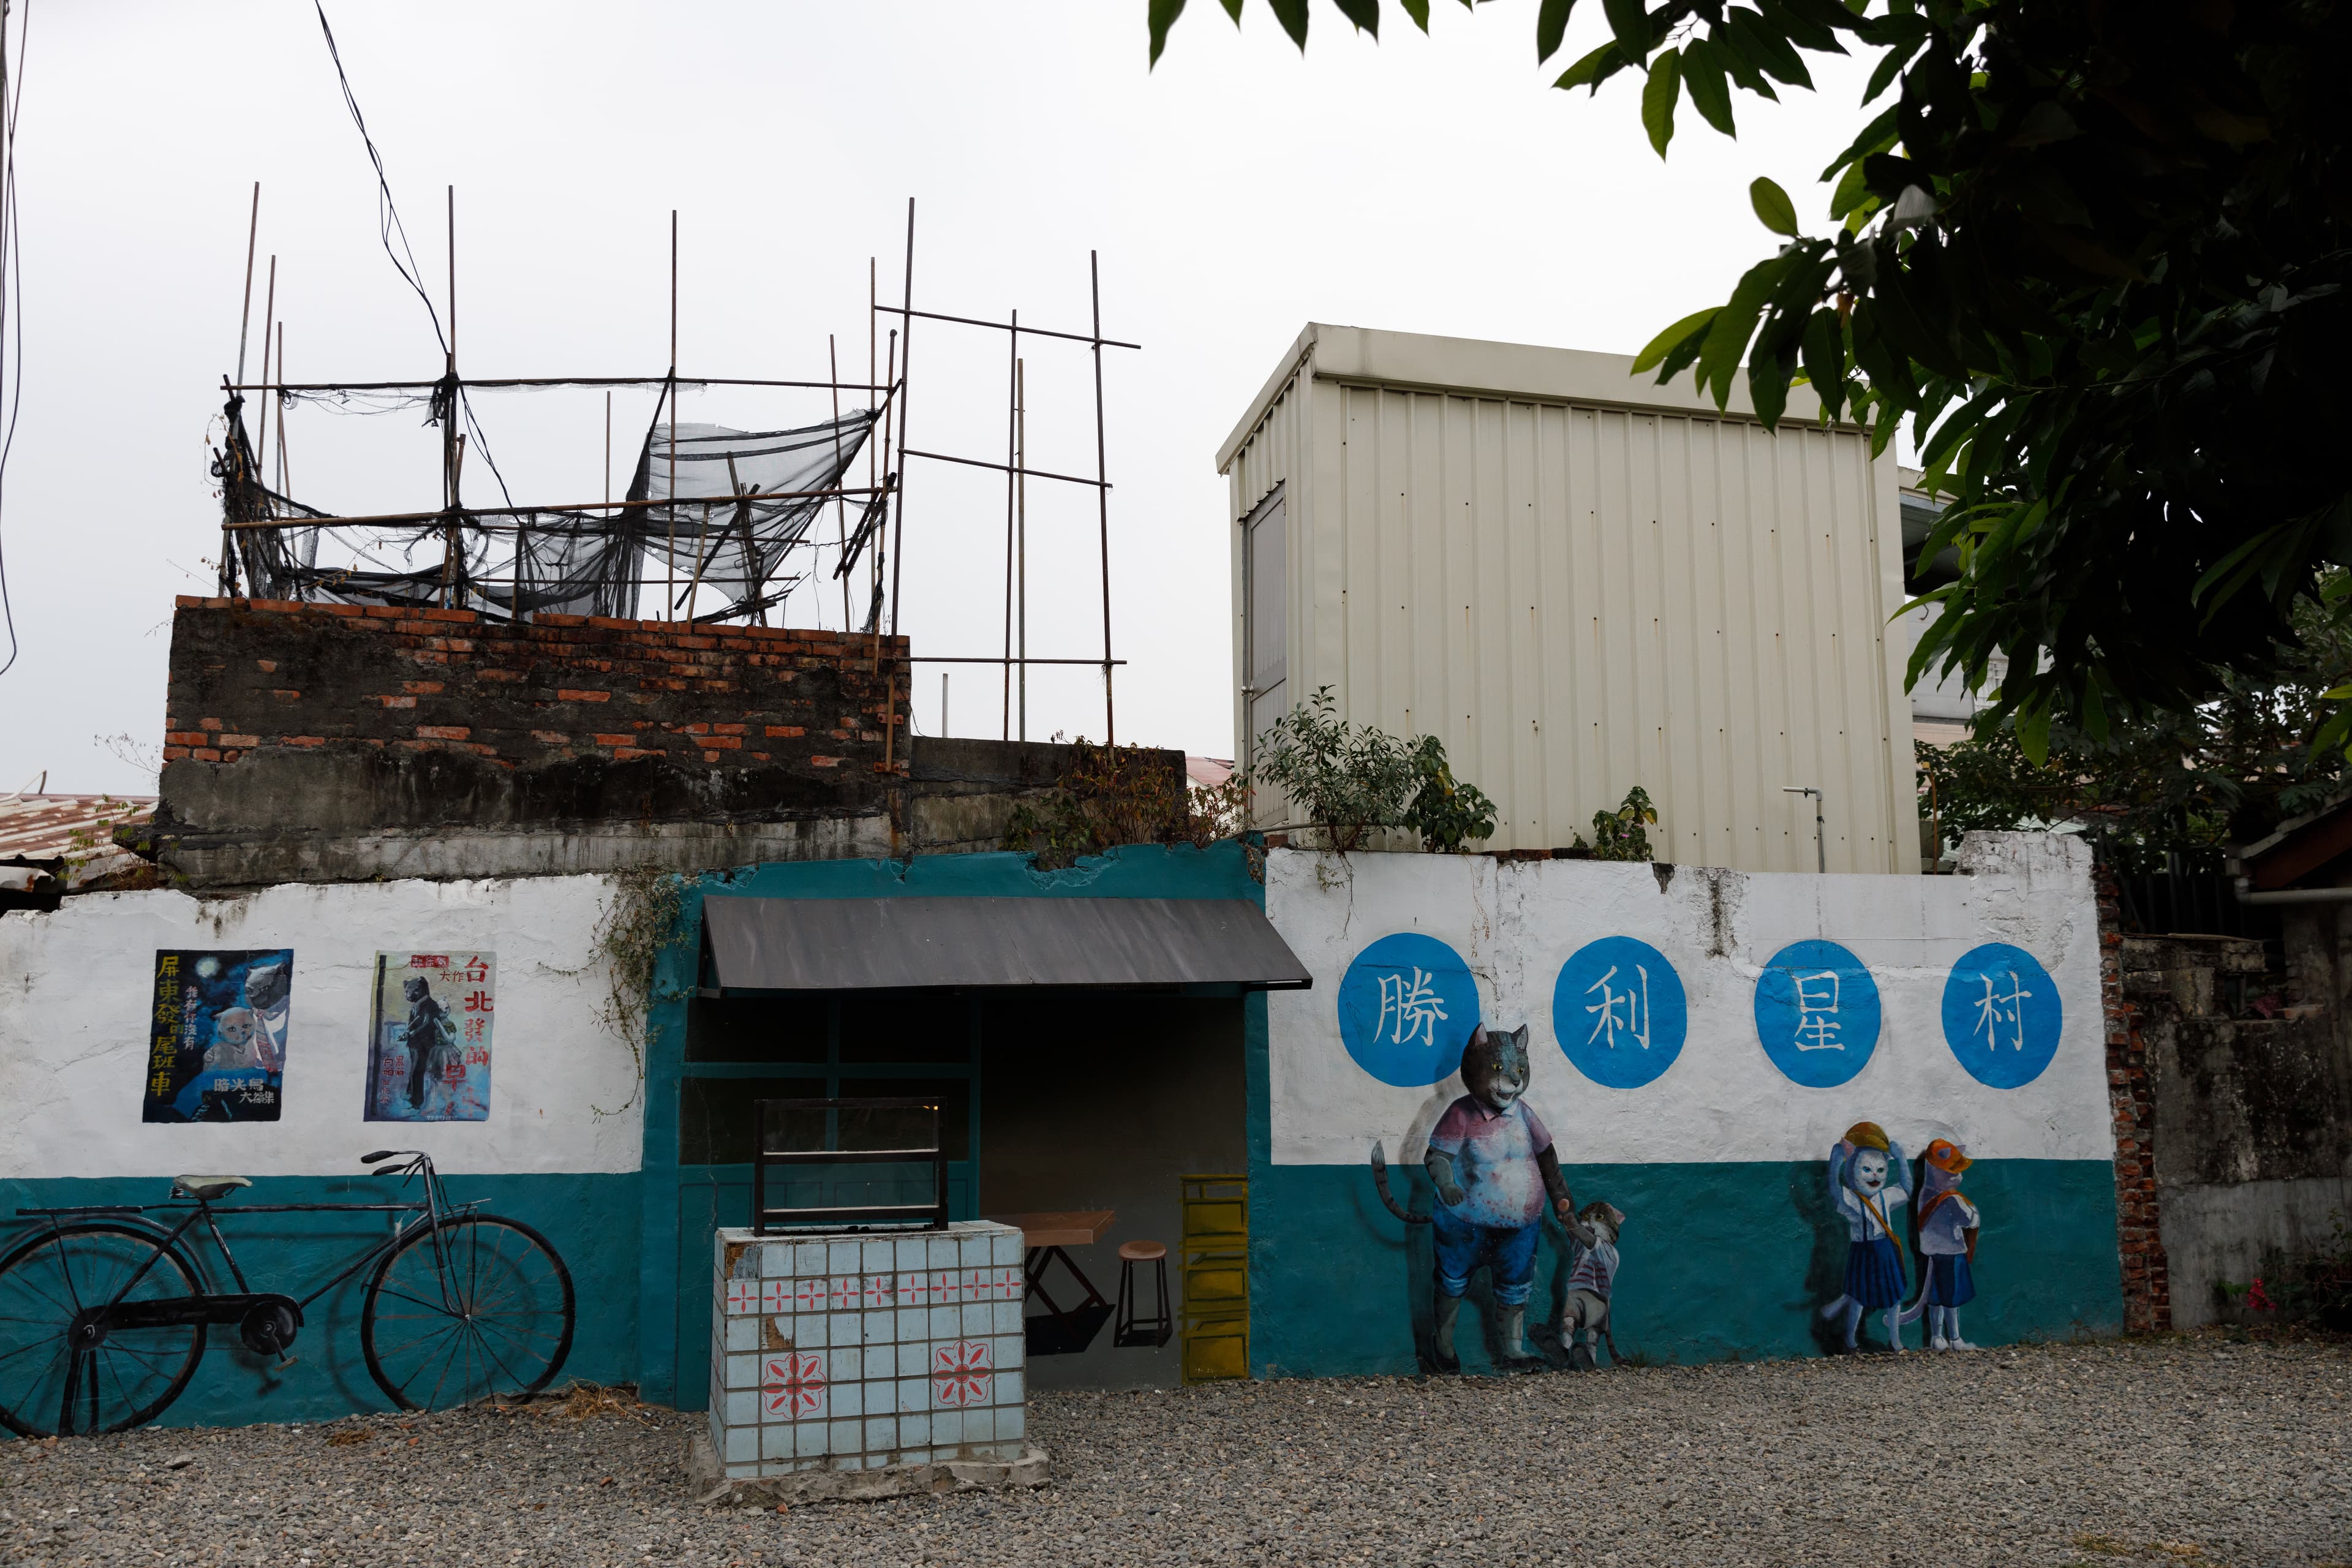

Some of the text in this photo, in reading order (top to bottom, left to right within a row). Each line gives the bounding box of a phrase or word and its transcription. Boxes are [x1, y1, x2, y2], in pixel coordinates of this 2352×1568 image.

[440, 970, 464, 982] 大作
[151, 956, 184, 1096] 屏東發的尾班車
